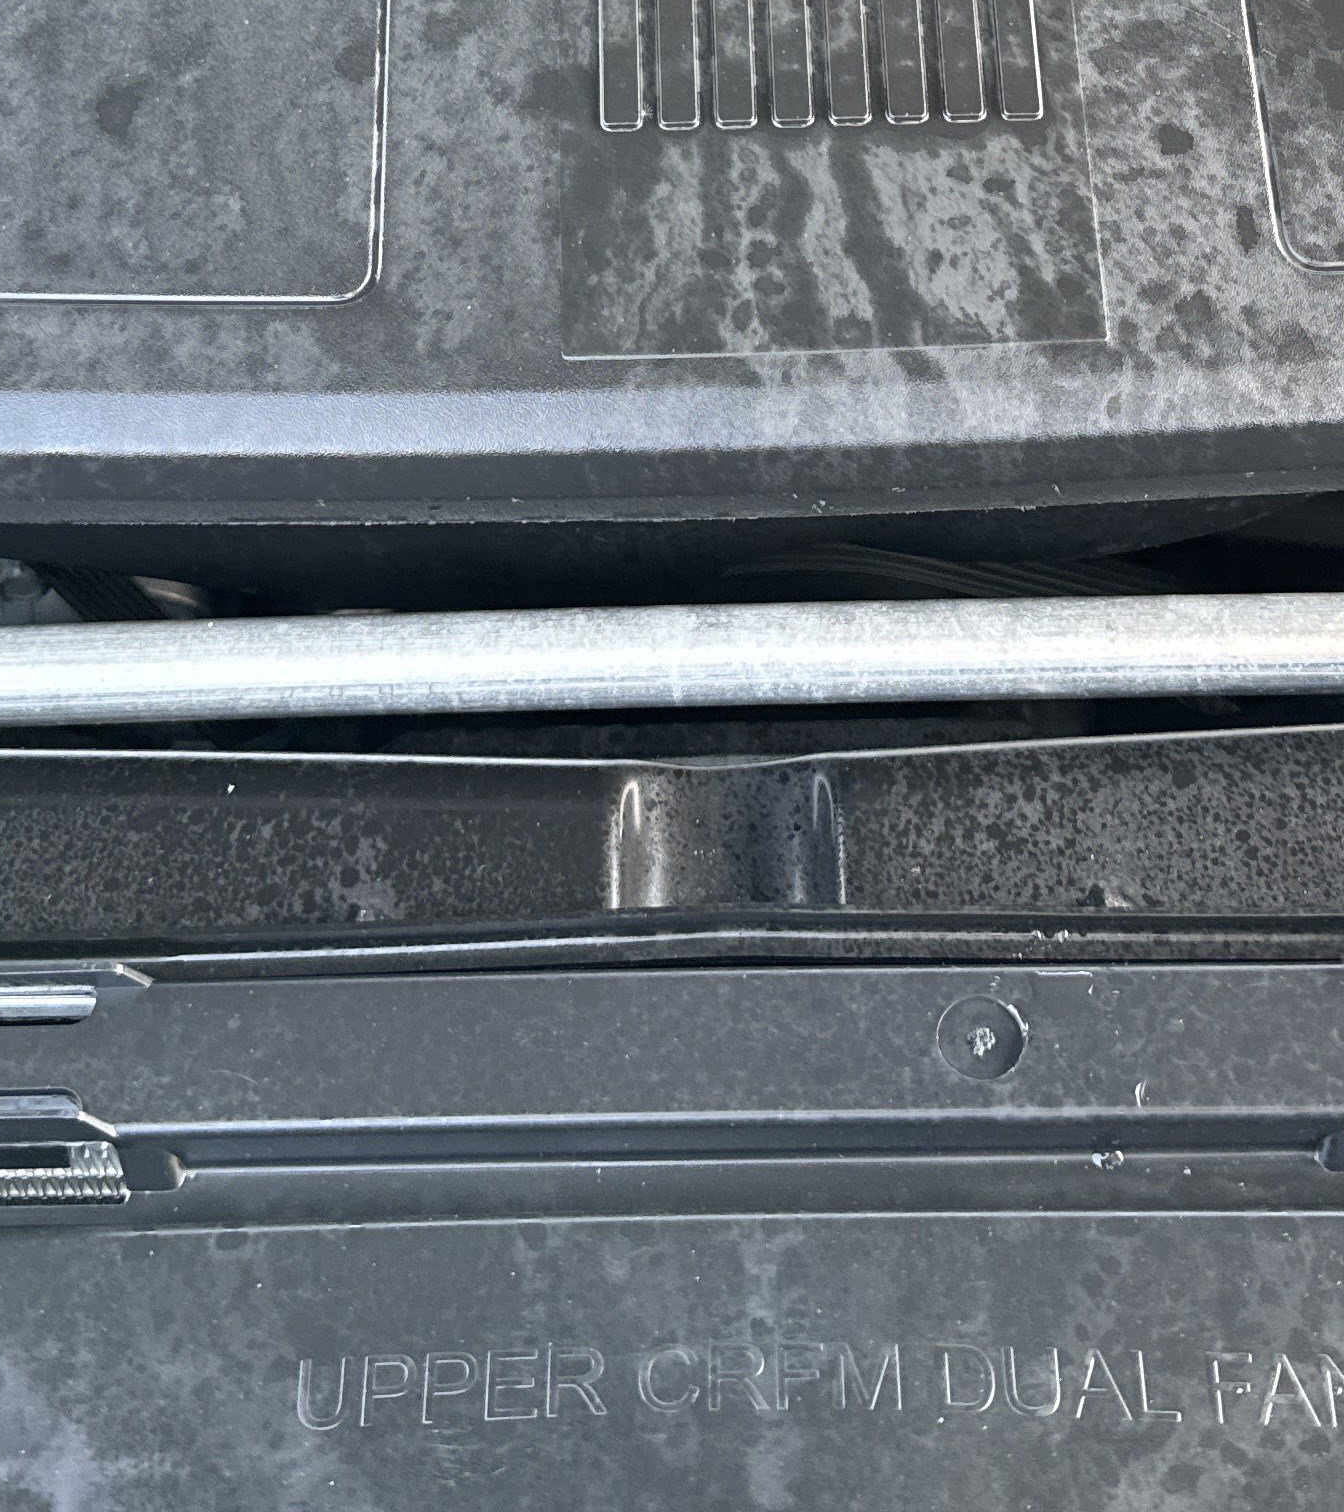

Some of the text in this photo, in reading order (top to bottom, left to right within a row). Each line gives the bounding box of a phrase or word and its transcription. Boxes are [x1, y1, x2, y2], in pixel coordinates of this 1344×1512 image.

[296, 1344, 608, 1431] UPPER
[637, 1341, 903, 1414] CRFM
[934, 1343, 1182, 1422] DUAL
